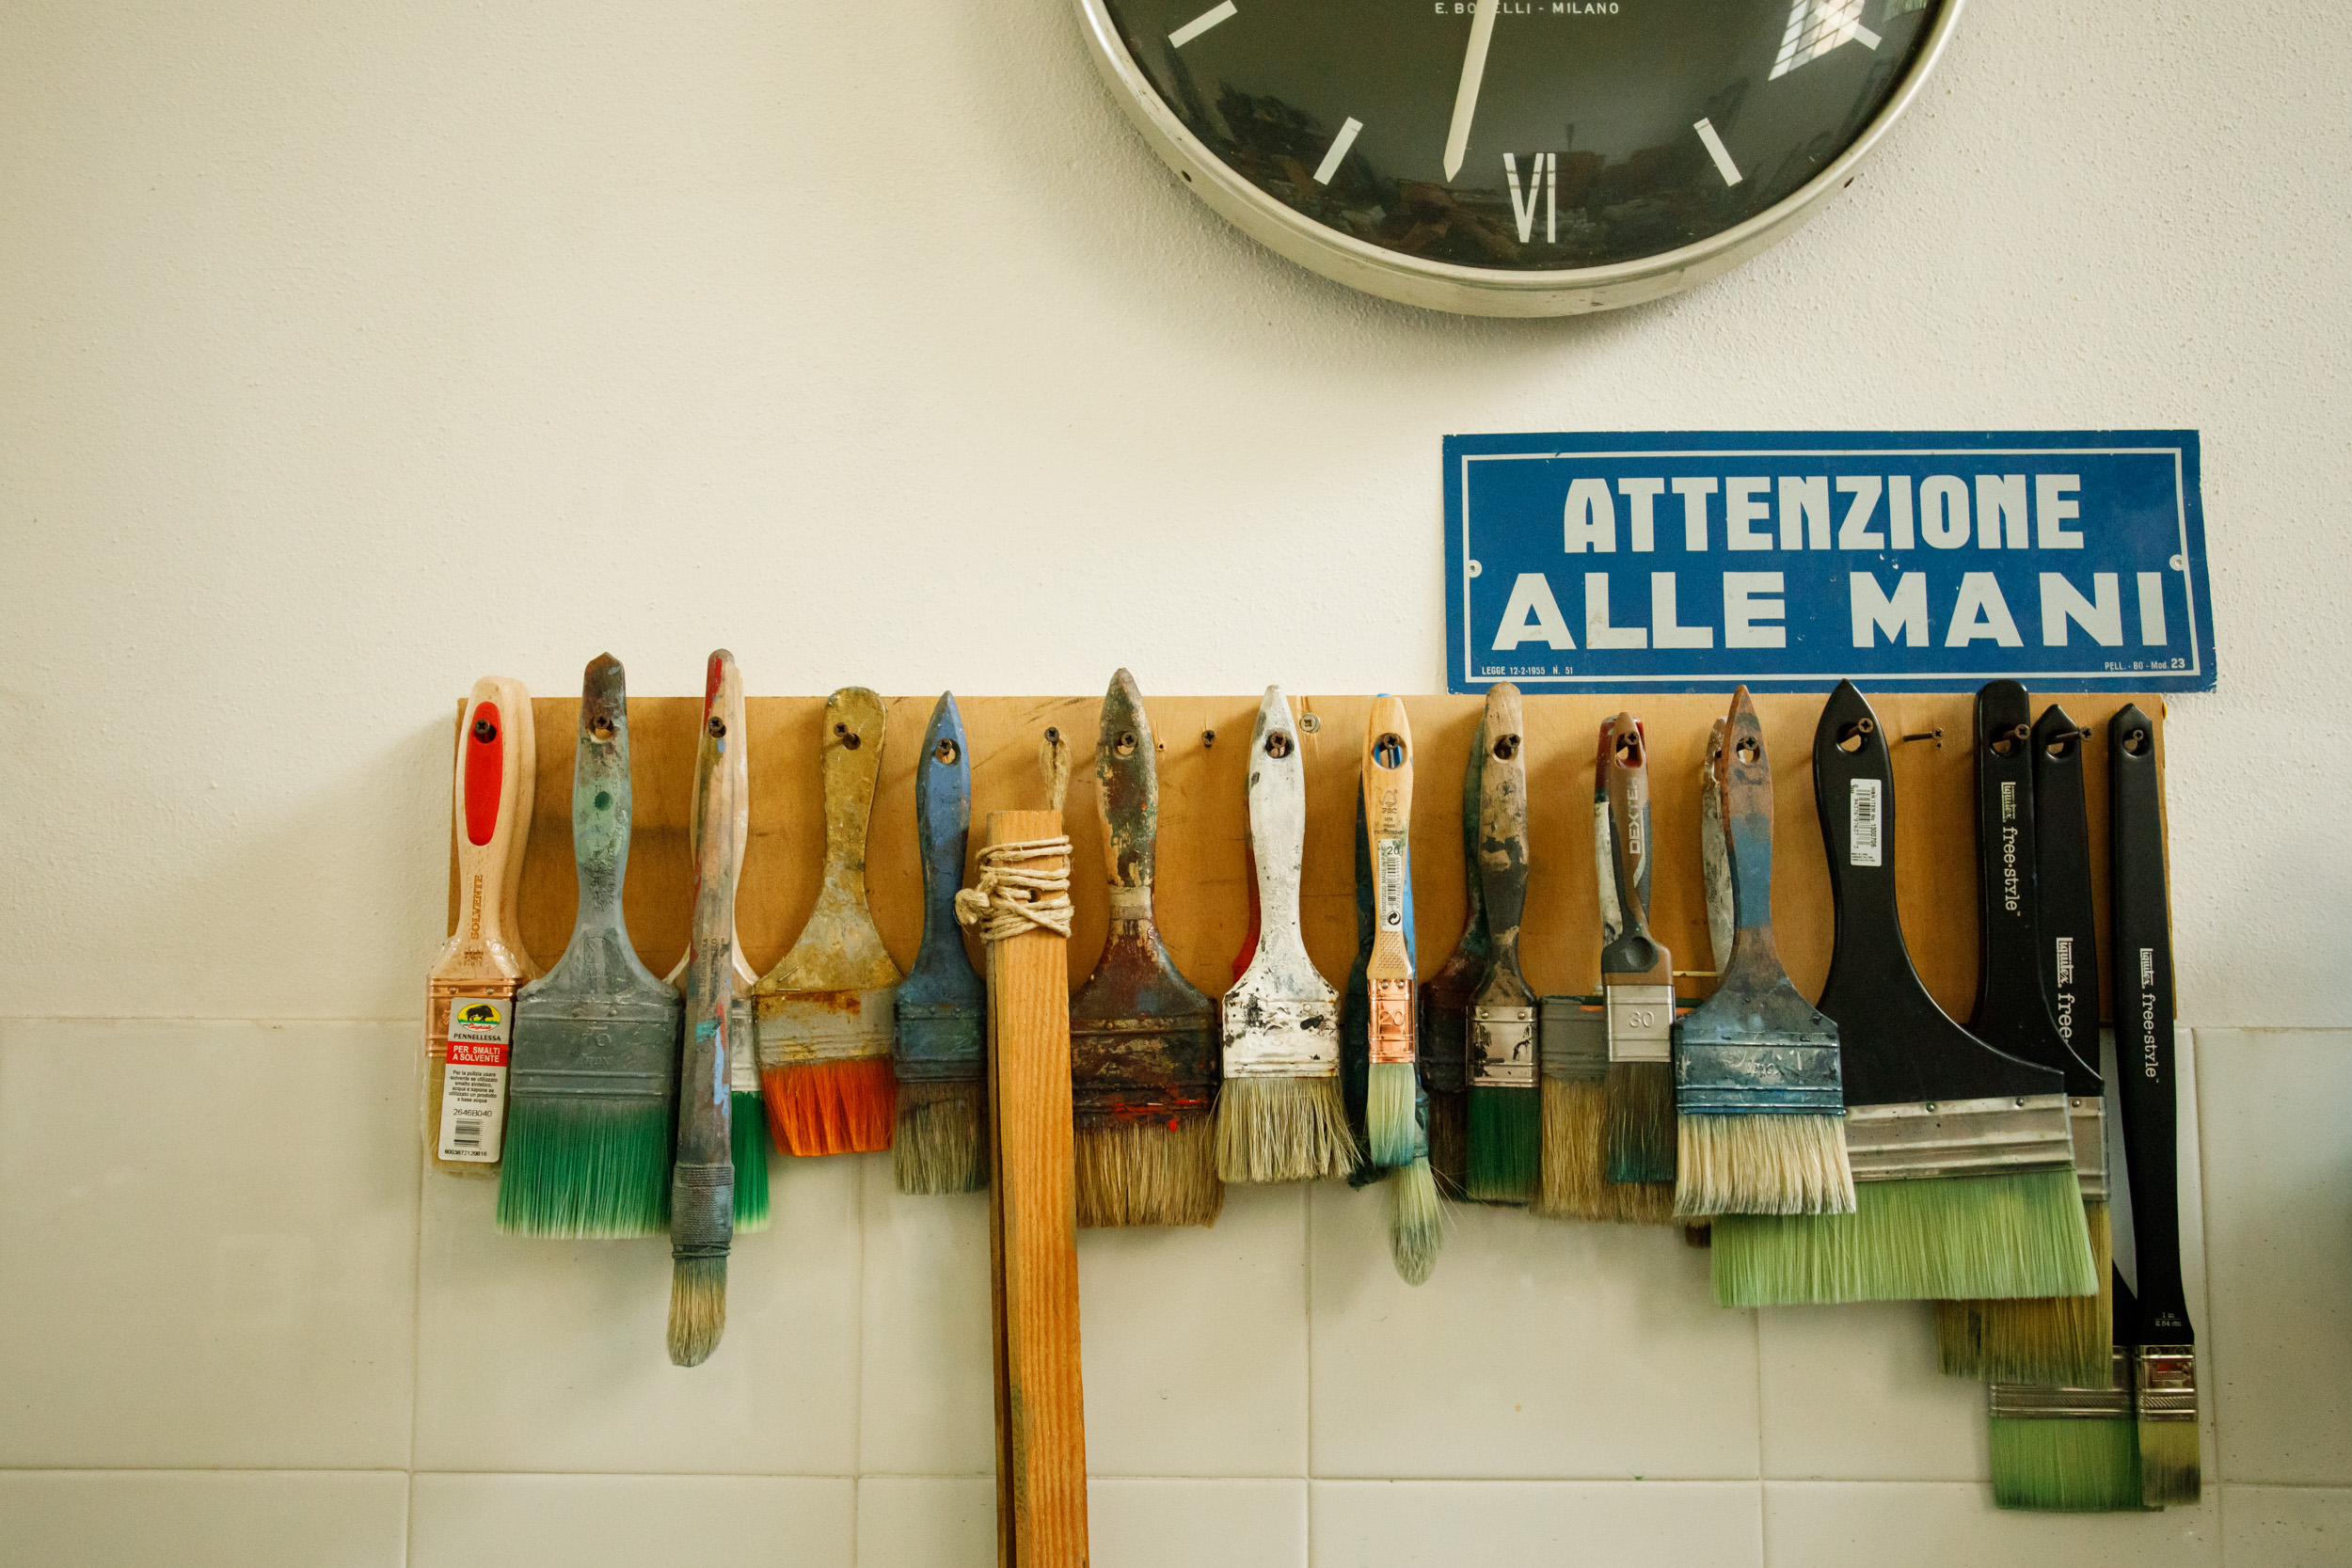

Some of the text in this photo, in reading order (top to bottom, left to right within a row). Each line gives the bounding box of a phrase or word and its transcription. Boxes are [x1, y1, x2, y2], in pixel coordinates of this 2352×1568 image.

[1435, 3, 1449, 14] E.
[1454, 3, 1531, 14] BOLLI
[1552, 3, 1619, 14] MILANO
[1502, 152, 1556, 244] VI
[1563, 474, 2084, 553] ATTENZIONE
[1491, 571, 2168, 651] ALLE MANI
[1482, 666, 1505, 675] LEGGE
[1510, 666, 1546, 675] 12-2-1955
[1565, 666, 1573, 675] 51
[2105, 661, 2126, 671] PELL.
[2151, 660, 2169, 670] Mod.
[2170, 657, 2185, 669] 23
[470, 874, 484, 941] SOLVENTE
[2056, 937, 2074, 987] Liquitex
[2139, 948, 2154, 989] Liquitex
[1629, 1010, 1655, 1029] 30
[453, 1033, 501, 1041] PENNELLESSA
[453, 1045, 500, 1055] PER SMALTI
[459, 1053, 500, 1063] SOLVENTE
